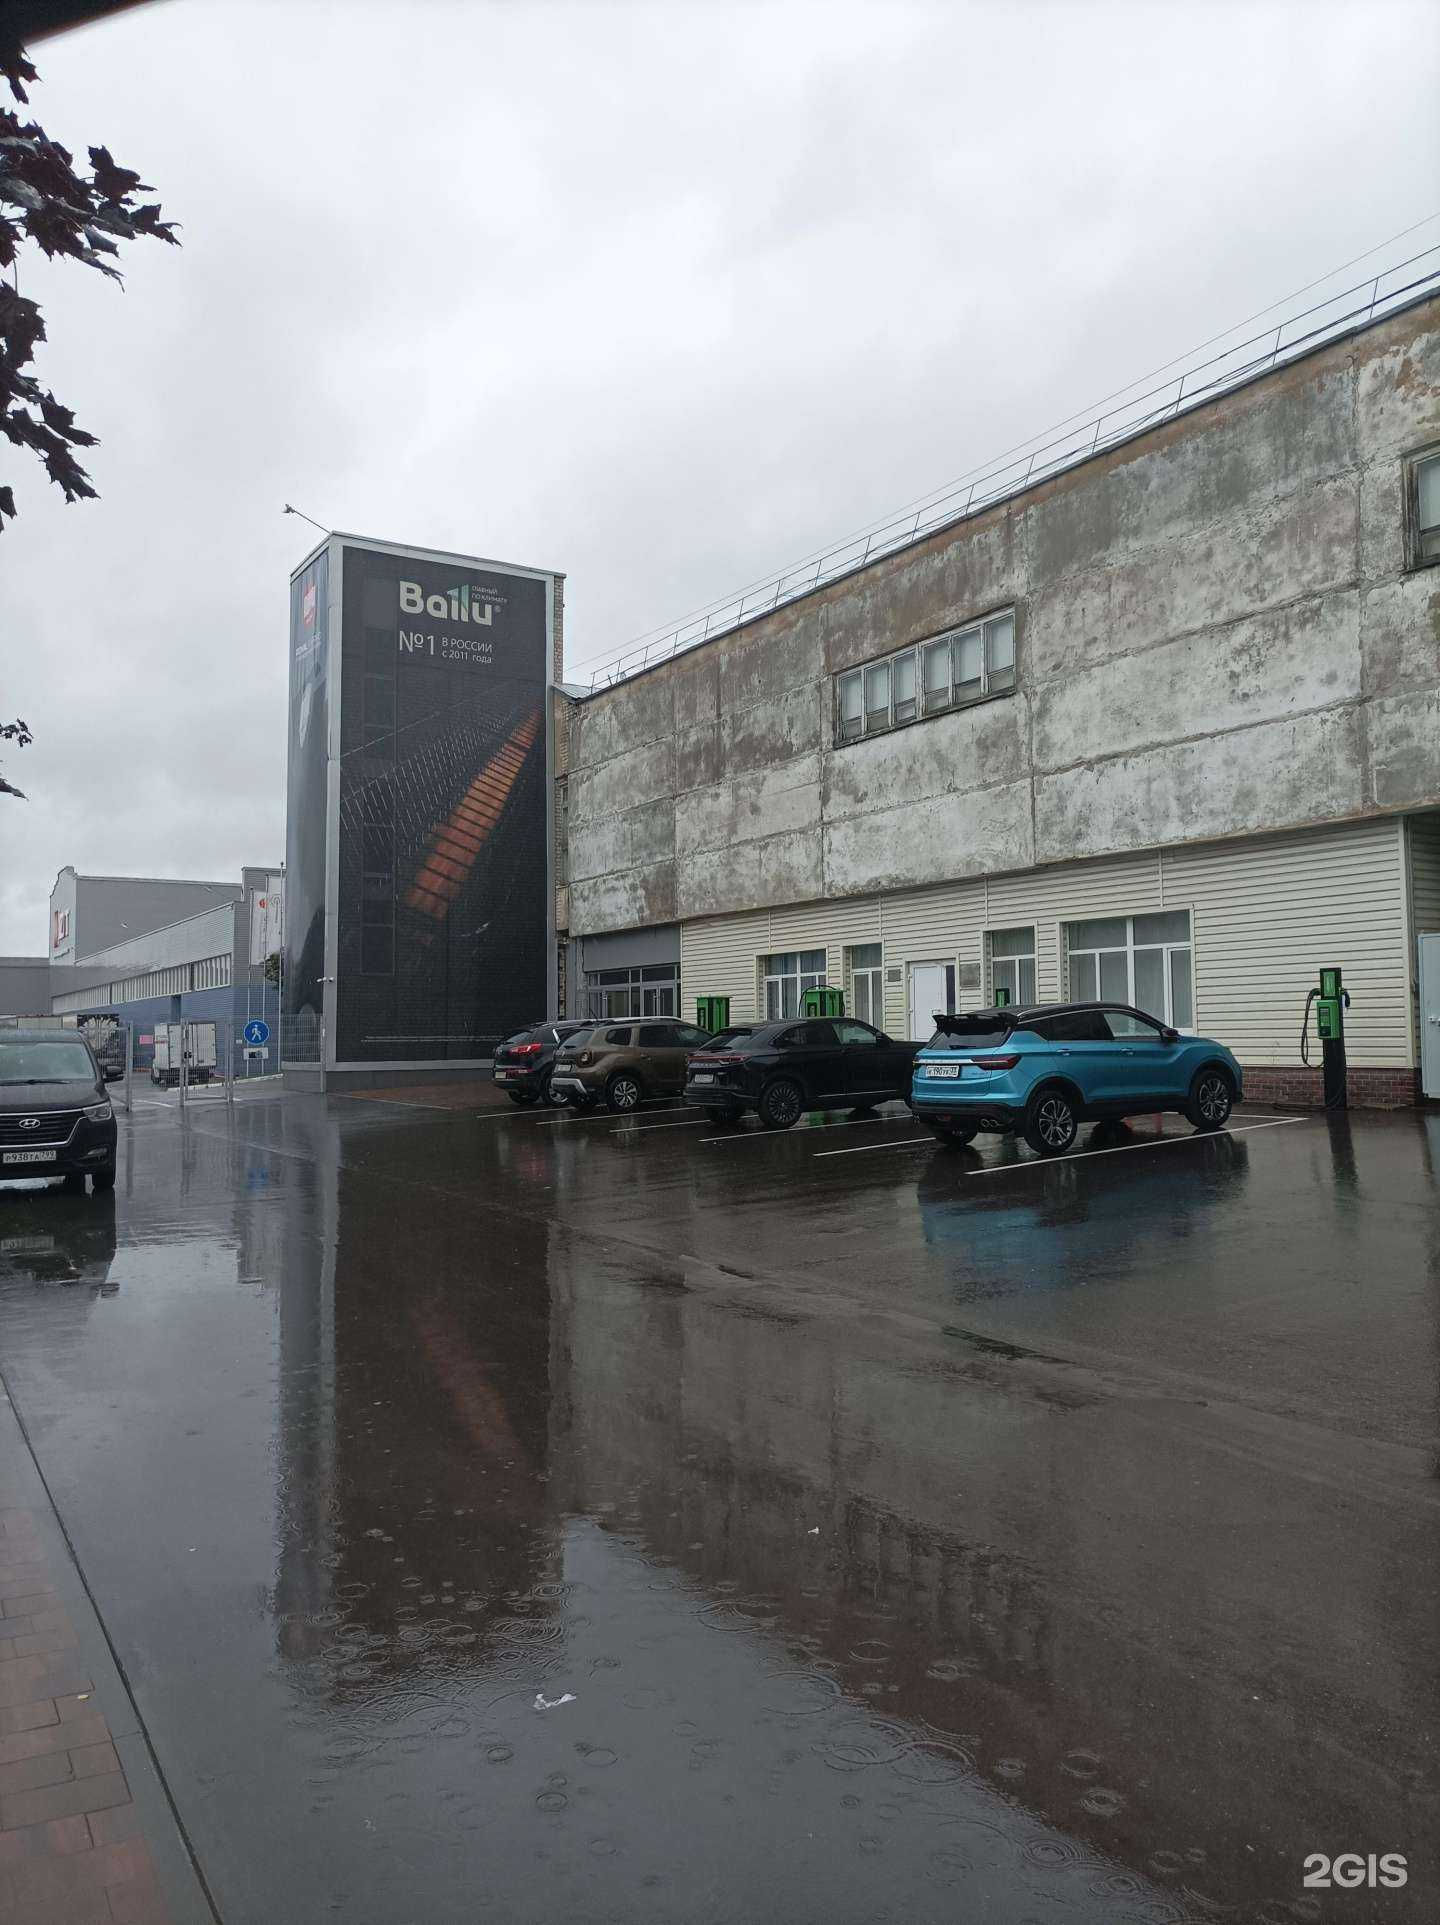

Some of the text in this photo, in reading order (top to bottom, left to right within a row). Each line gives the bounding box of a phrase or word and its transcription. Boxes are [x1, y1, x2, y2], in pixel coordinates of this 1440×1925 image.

[399, 580, 492, 626] Ballu
[450, 638, 493, 653] РОССИИ
[448, 650, 468, 661] 2011
[472, 654, 492, 664] года
